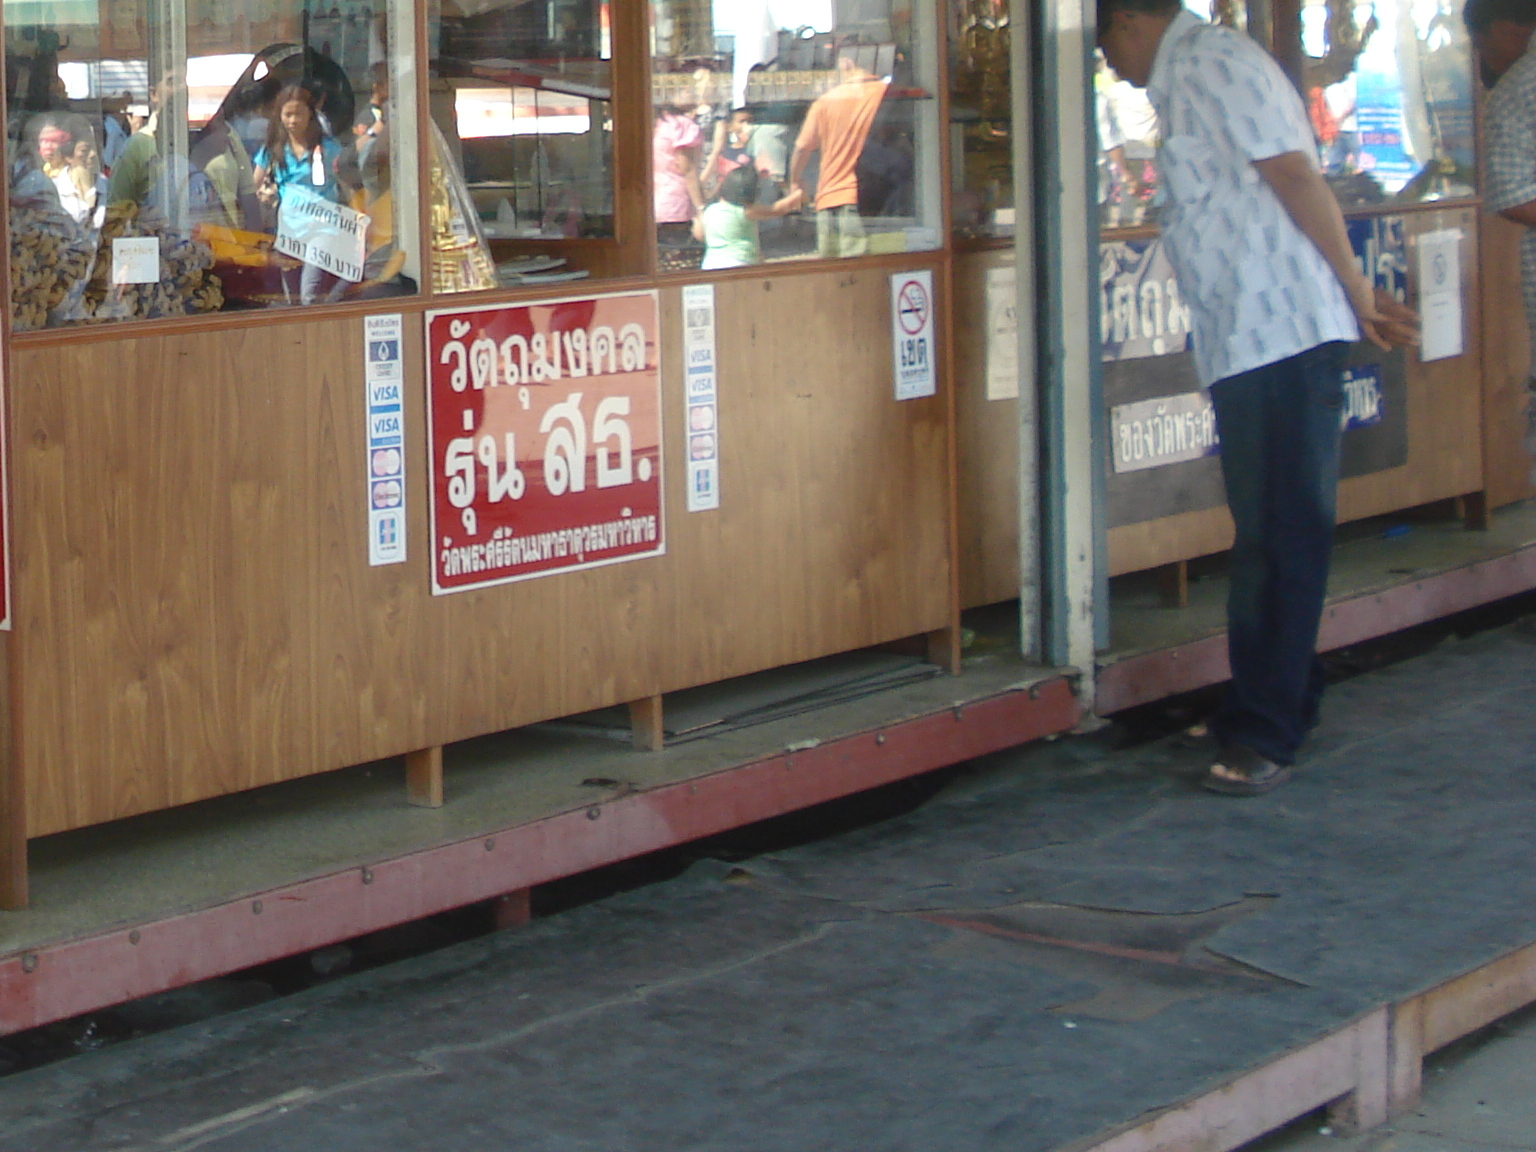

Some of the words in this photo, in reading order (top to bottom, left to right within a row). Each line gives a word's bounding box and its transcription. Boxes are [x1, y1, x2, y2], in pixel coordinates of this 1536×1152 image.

[279, 233, 308, 258] ราคา
[310, 246, 332, 268] 350
[335, 258, 362, 281] บาท
[690, 349, 712, 363] VISA
[440, 319, 647, 411] วัตถุมงคล
[373, 385, 399, 401] VISA
[691, 378, 713, 392] VISA
[374, 417, 400, 433] VISA
[445, 409, 527, 536] รุ่น
[539, 391, 654, 497] สธ.
